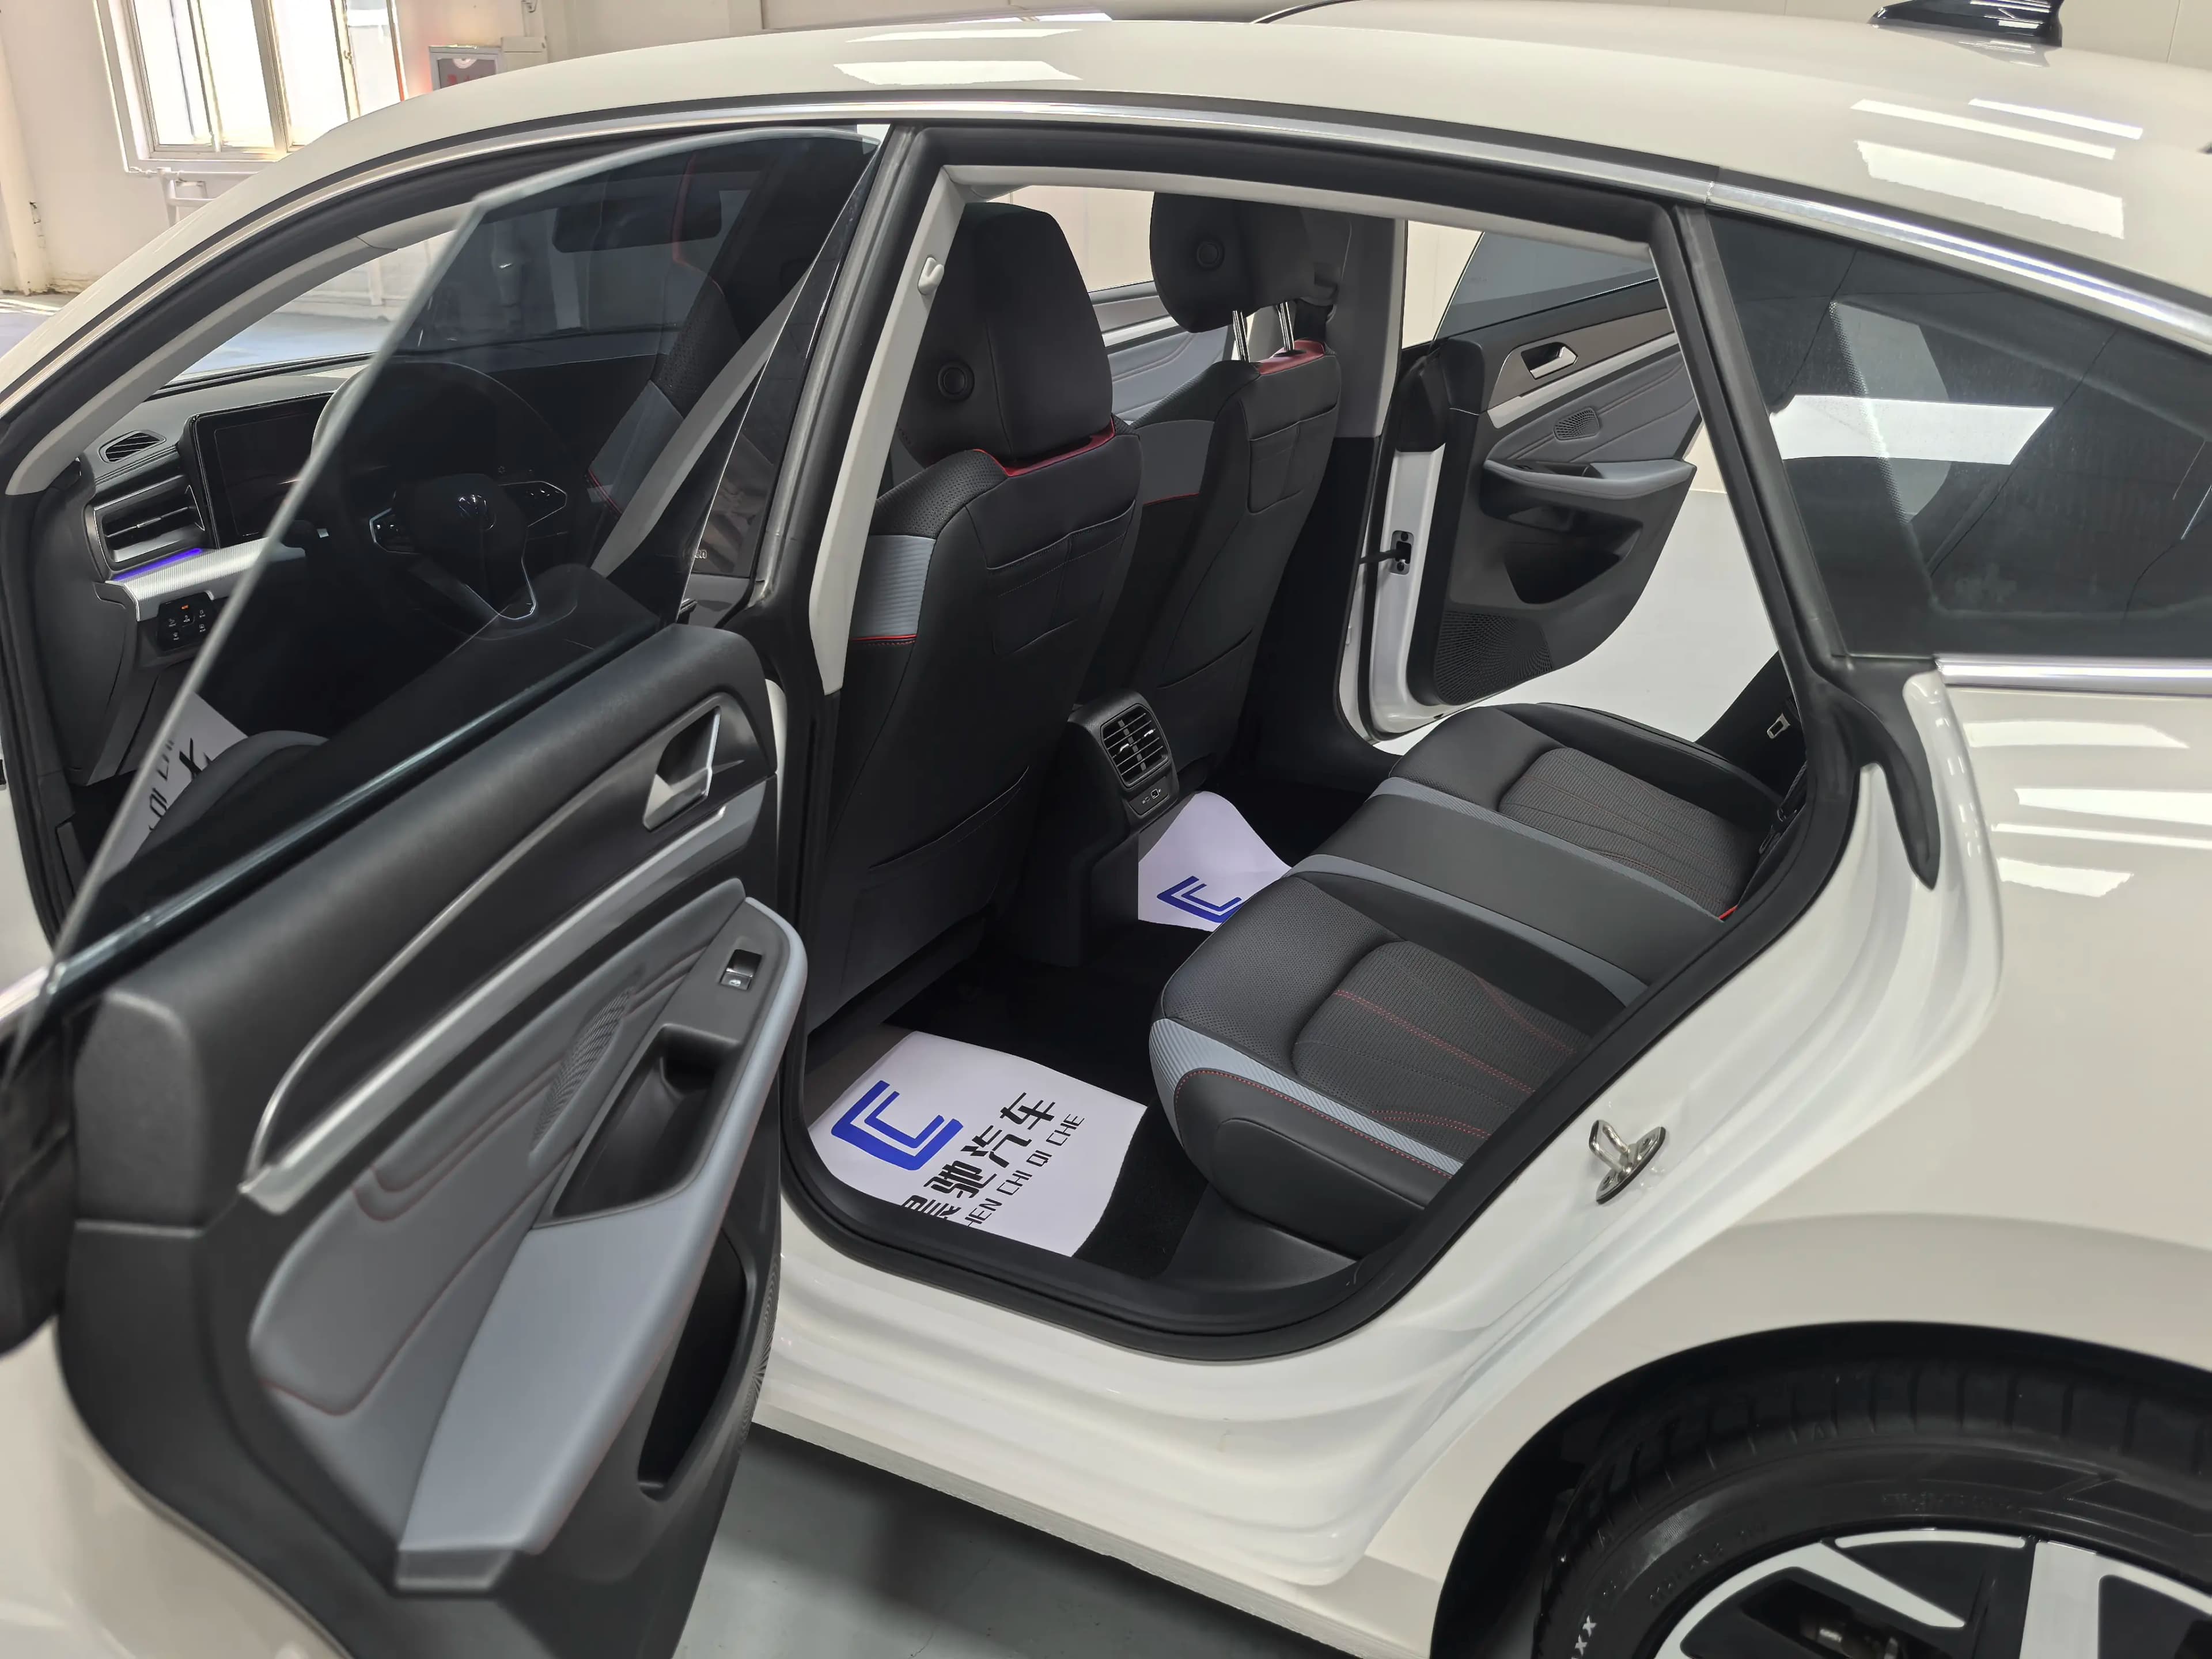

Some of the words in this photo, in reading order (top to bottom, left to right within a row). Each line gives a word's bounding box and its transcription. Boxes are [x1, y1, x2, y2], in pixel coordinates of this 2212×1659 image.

[996, 1170, 1033, 1196] CHI
[1026, 1150, 1053, 1167] QI
[1046, 1113, 1085, 1146] CHE
